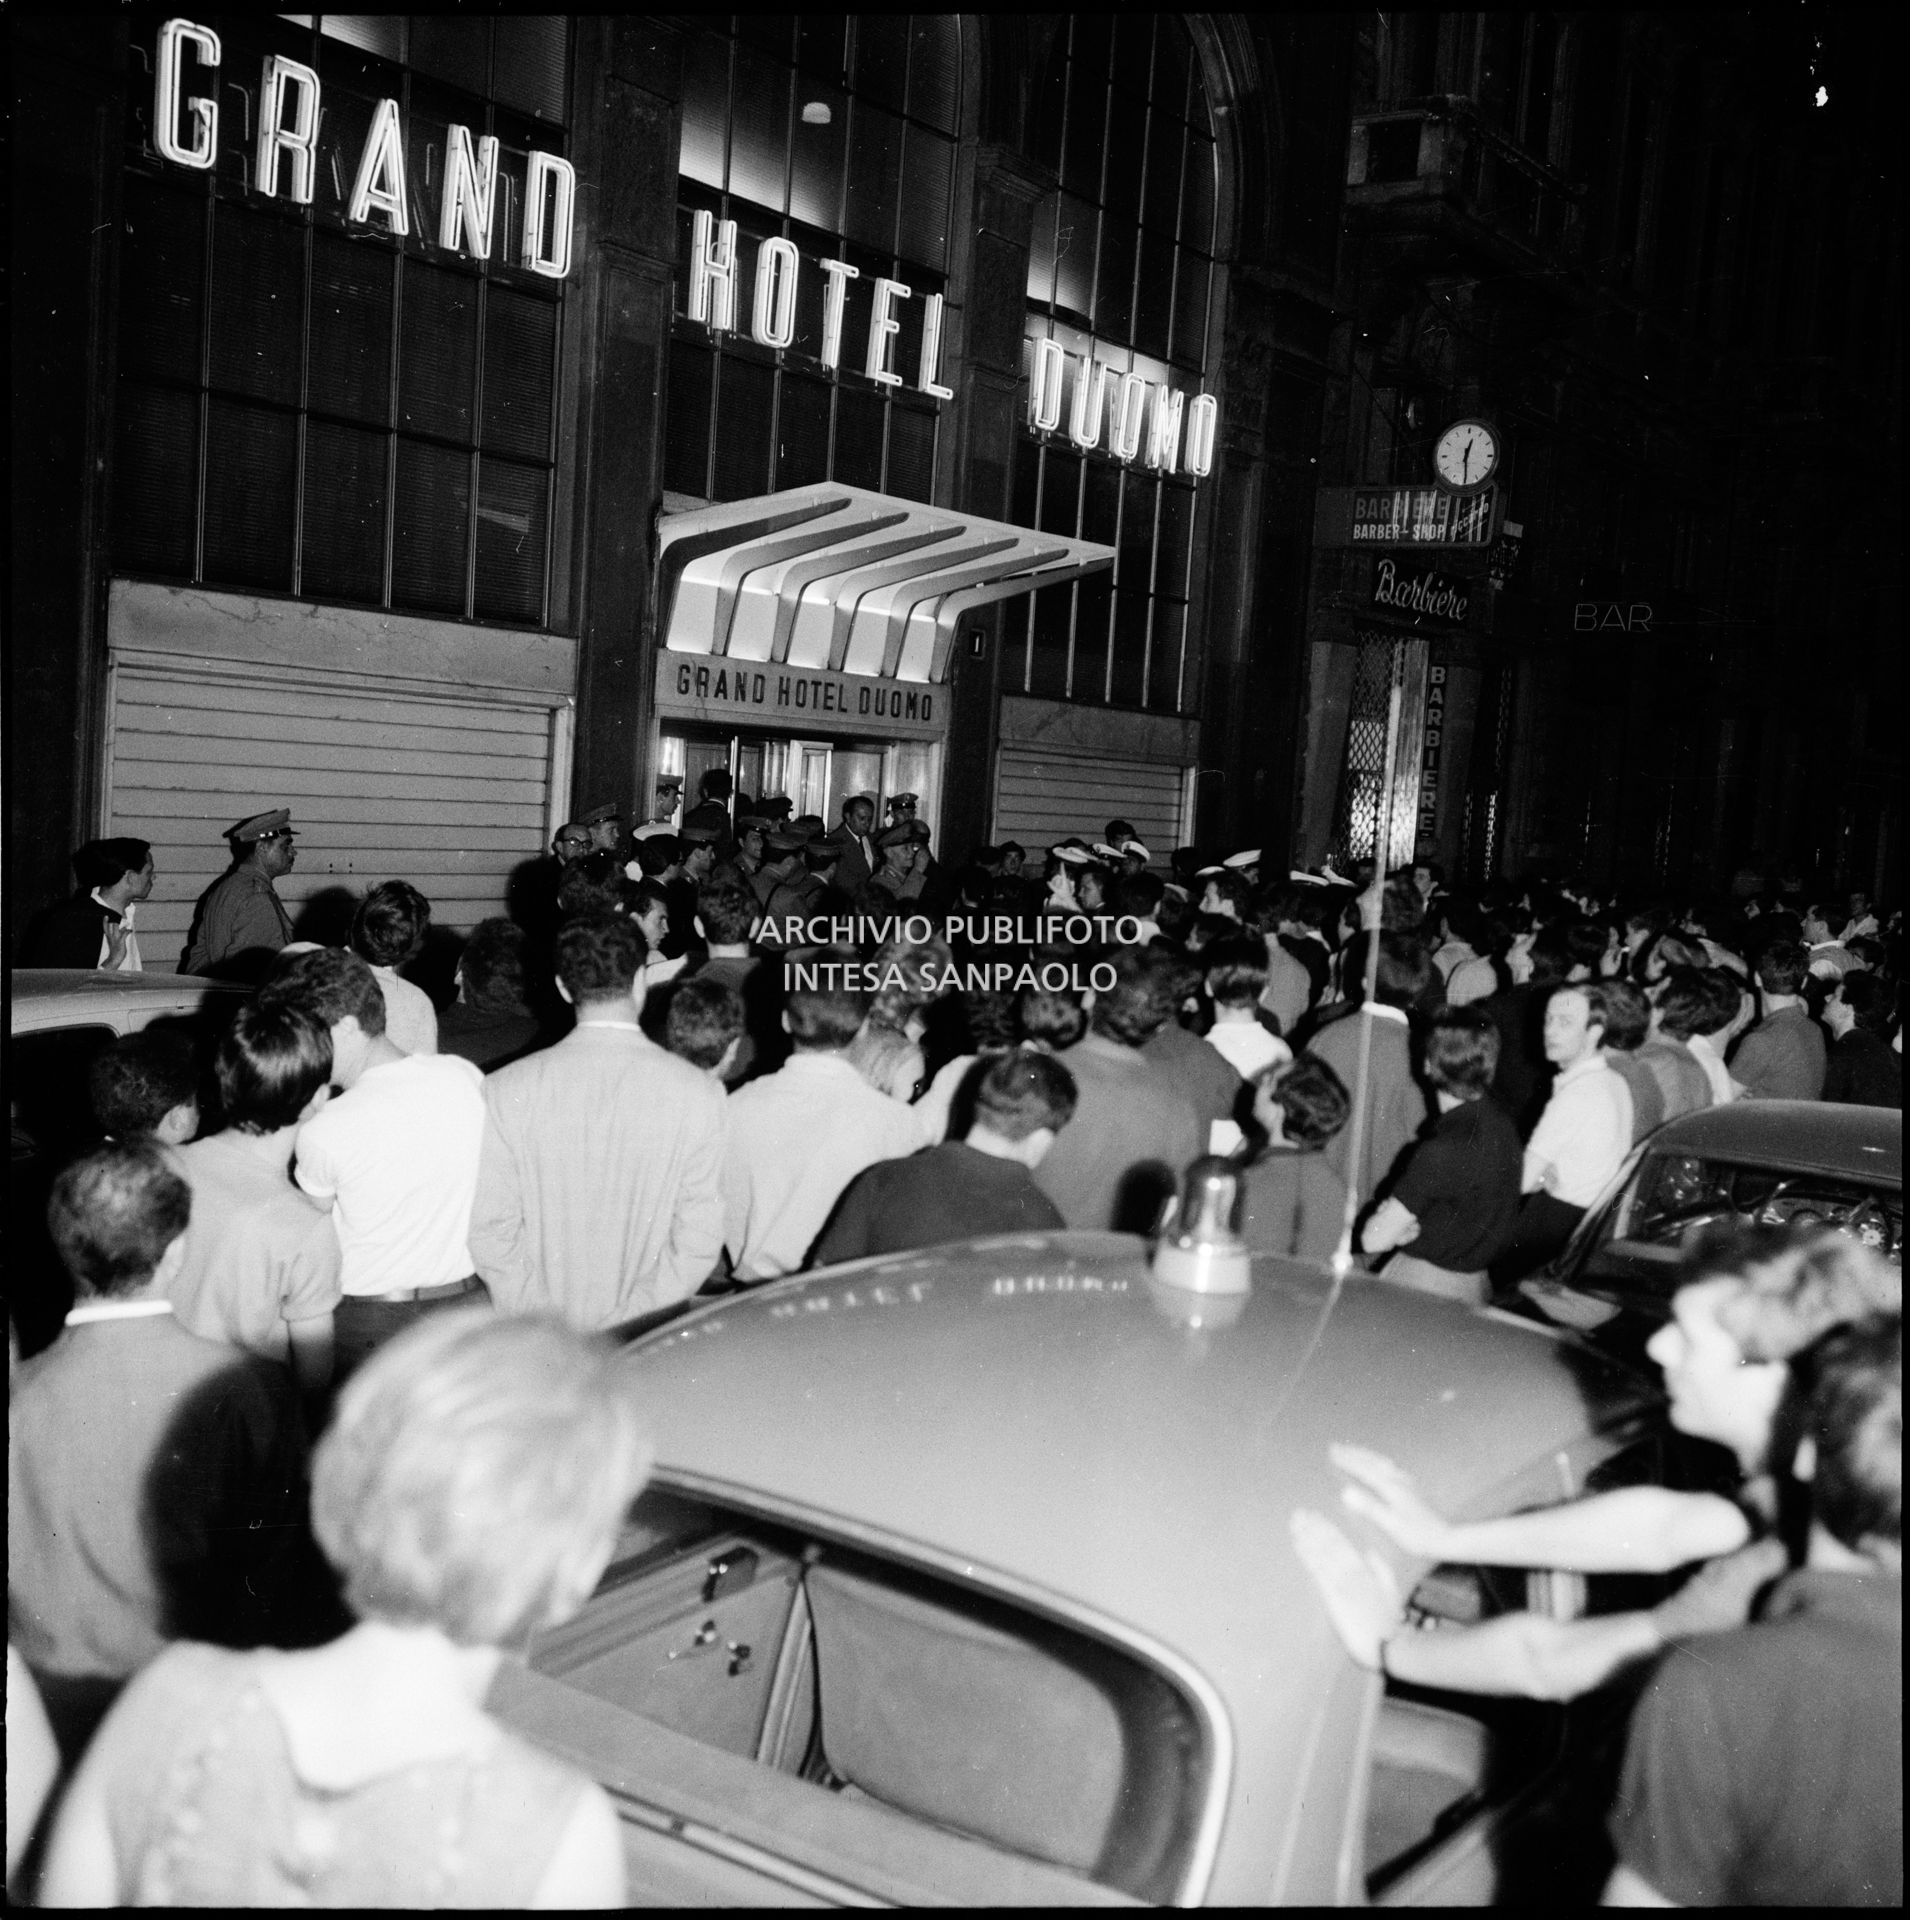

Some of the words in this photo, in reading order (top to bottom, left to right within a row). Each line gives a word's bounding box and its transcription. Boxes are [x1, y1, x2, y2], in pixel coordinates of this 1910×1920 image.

[153, 18, 576, 279] GRAND
[687, 209, 953, 400] HOTEL
[1029, 337, 1218, 478] DUOMO
[1354, 497, 1447, 521] BARBEE
[1373, 558, 1469, 621] Barbiere
[1573, 602, 1654, 633] BAR
[676, 663, 766, 705] GRAND
[777, 675, 849, 713] HOTEL
[858, 685, 933, 721] DUOMO
[1418, 665, 1447, 831] BARBIERE
